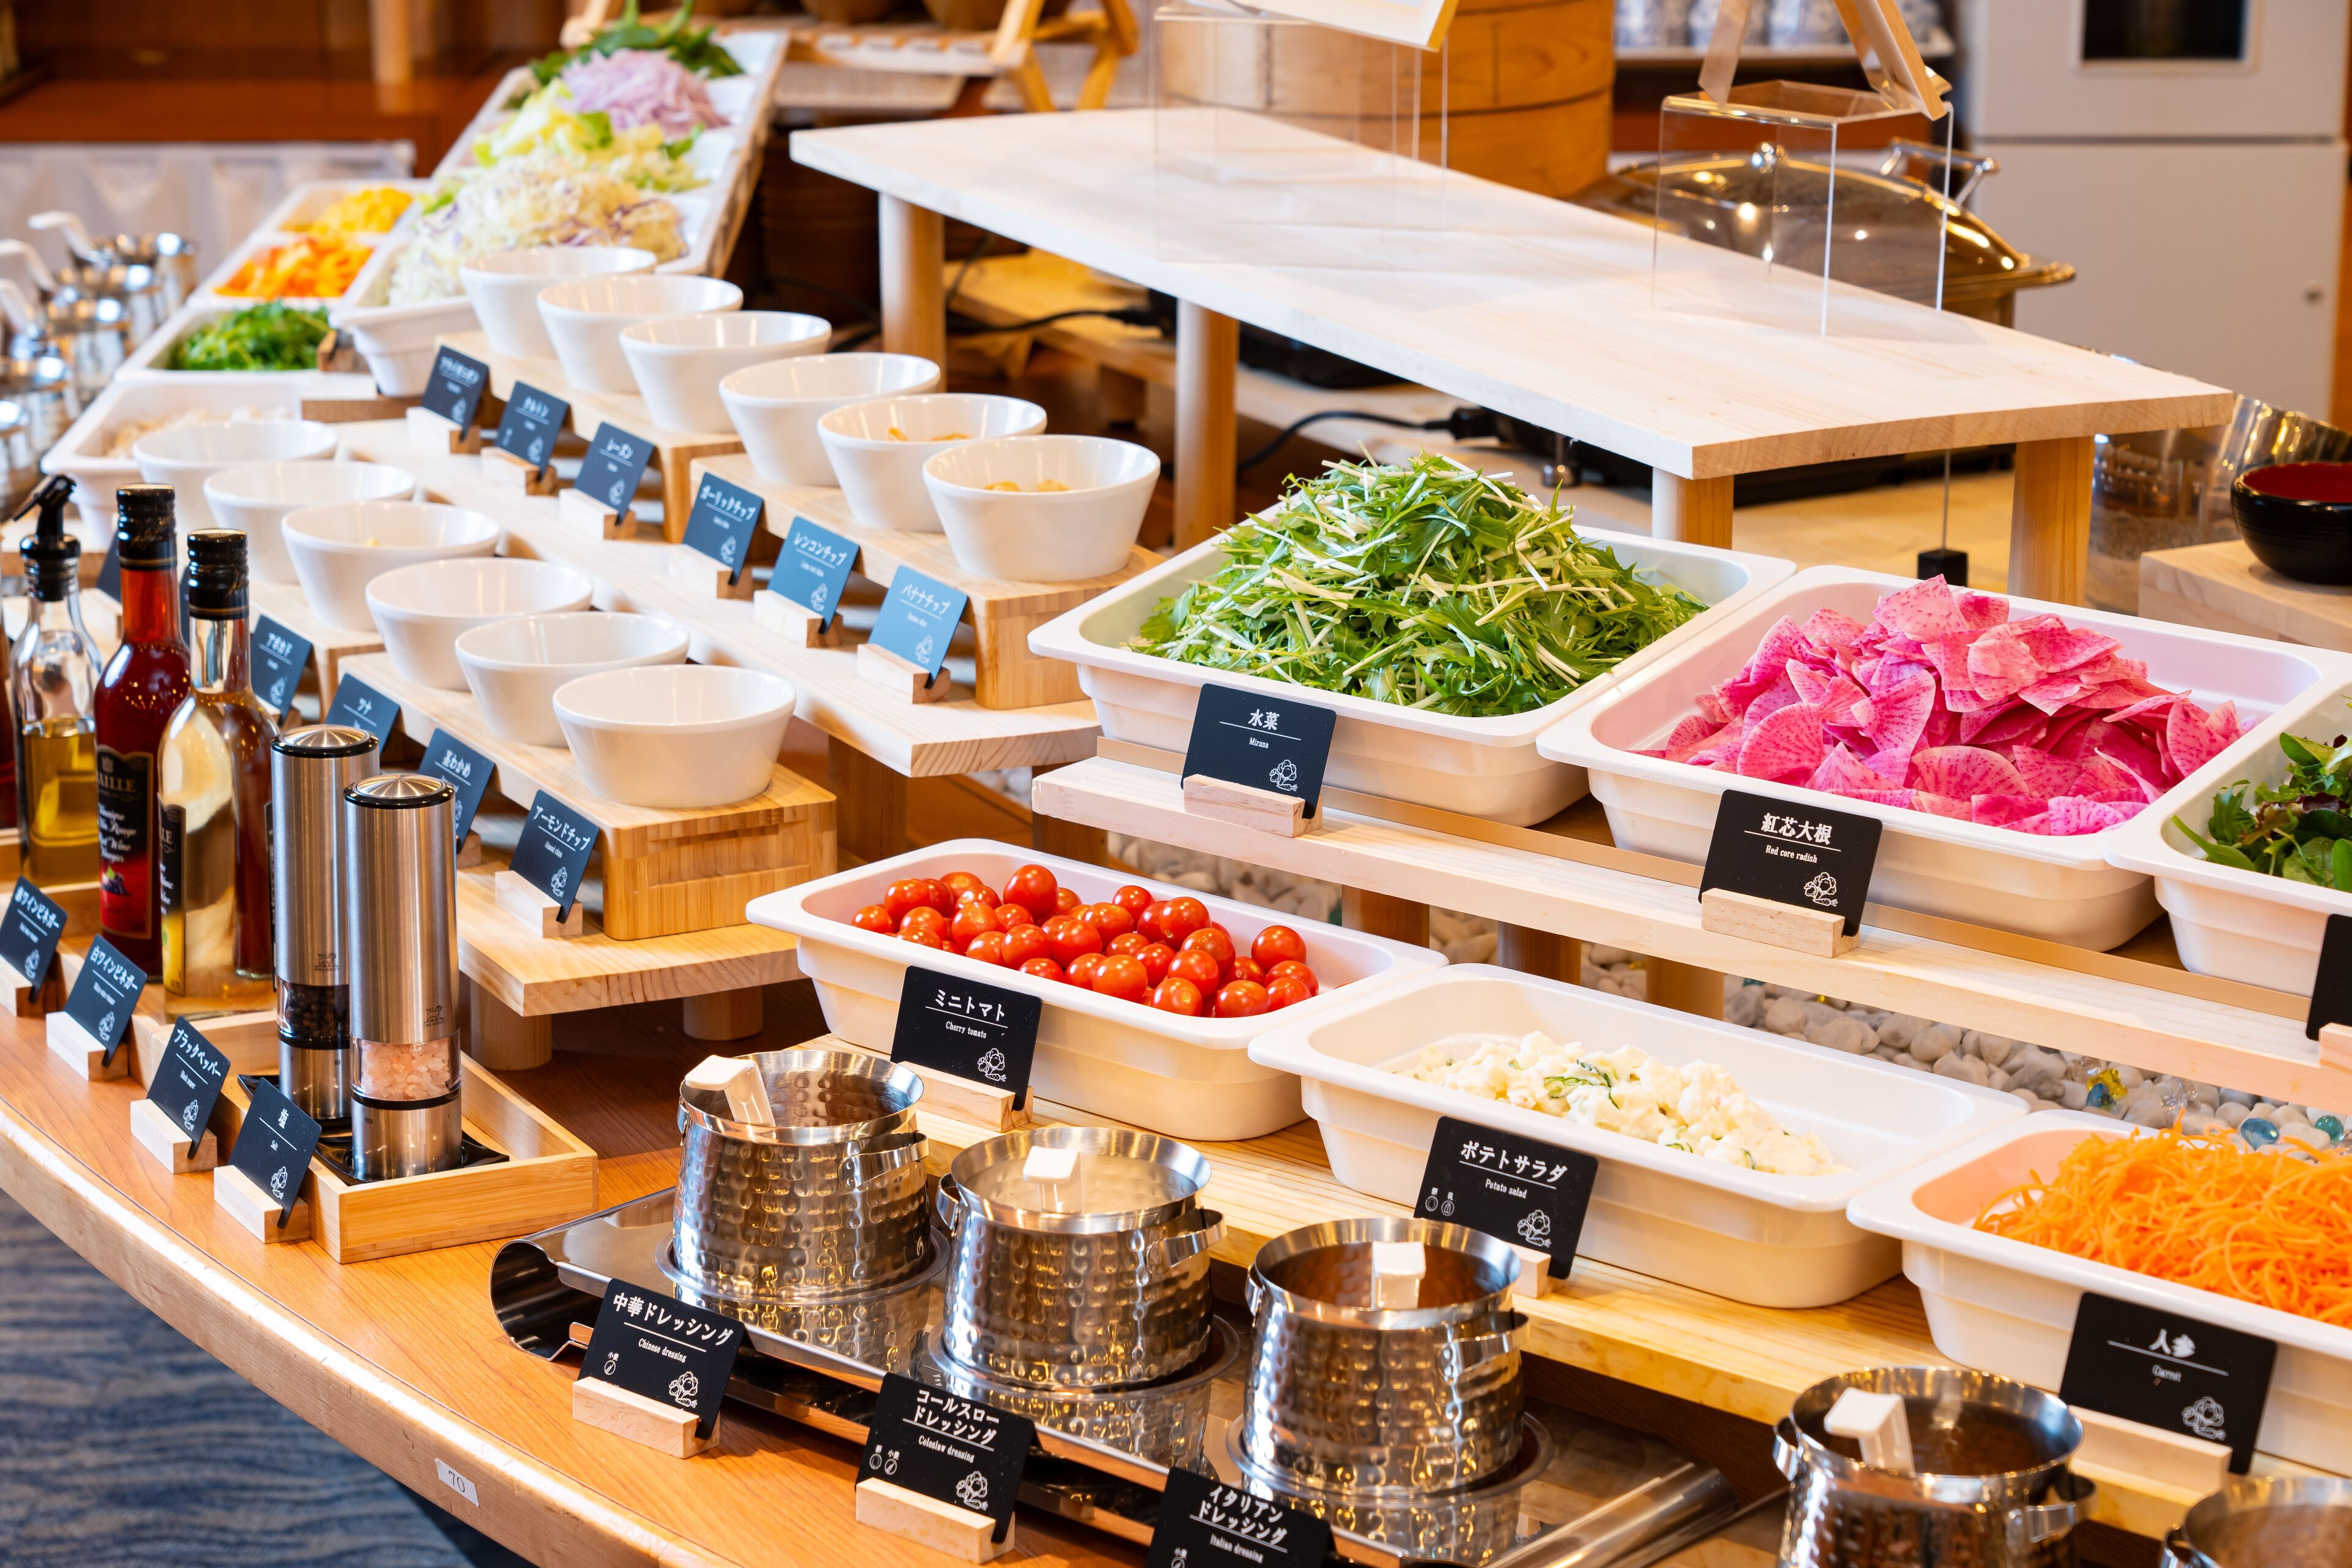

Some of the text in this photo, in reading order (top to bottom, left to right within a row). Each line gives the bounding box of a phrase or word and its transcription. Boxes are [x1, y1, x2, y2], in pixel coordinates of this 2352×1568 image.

[794, 532, 848, 567] レンコンチップ
[902, 584, 951, 615] バナナチップ
[357, 698, 372, 715] ツナ
[1248, 709, 1280, 731] 水菜
[1249, 737, 1269, 749] Mizuna
[442, 749, 472, 778] 茎わかめ
[97, 773, 136, 793] AILLE
[533, 805, 591, 851] アーモンドチップ
[1761, 813, 1833, 845] 紅芯大根
[1765, 845, 1817, 863] Red core radish
[90, 945, 138, 990] 白ワインビネガー
[935, 989, 1005, 1022] ミニトマト
[946, 1020, 987, 1039] Cherry tomato
[174, 1028, 221, 1077] ブラックペッパー
[278, 1107, 289, 1129] 塩
[270, 1140, 279, 1152] Salt
[1460, 1140, 1568, 1183] ポテトサラダ
[1485, 1178, 1528, 1199] Potato salad
[613, 1292, 734, 1346] 中華ドレッシング
[638, 1338, 687, 1363] Chinese dressing
[2152, 1364, 2182, 1382] Carrot
[917, 1389, 1000, 1424] コールスロー
[914, 1405, 997, 1445] ドレッシング
[918, 1434, 975, 1463] Coleslaw dressing
[448, 1470, 466, 1493] 70
[1209, 1485, 1283, 1523] イタリアン
[1199, 1500, 1287, 1545] ドレッシング
[1210, 1533, 1264, 1564] Italian dressing
